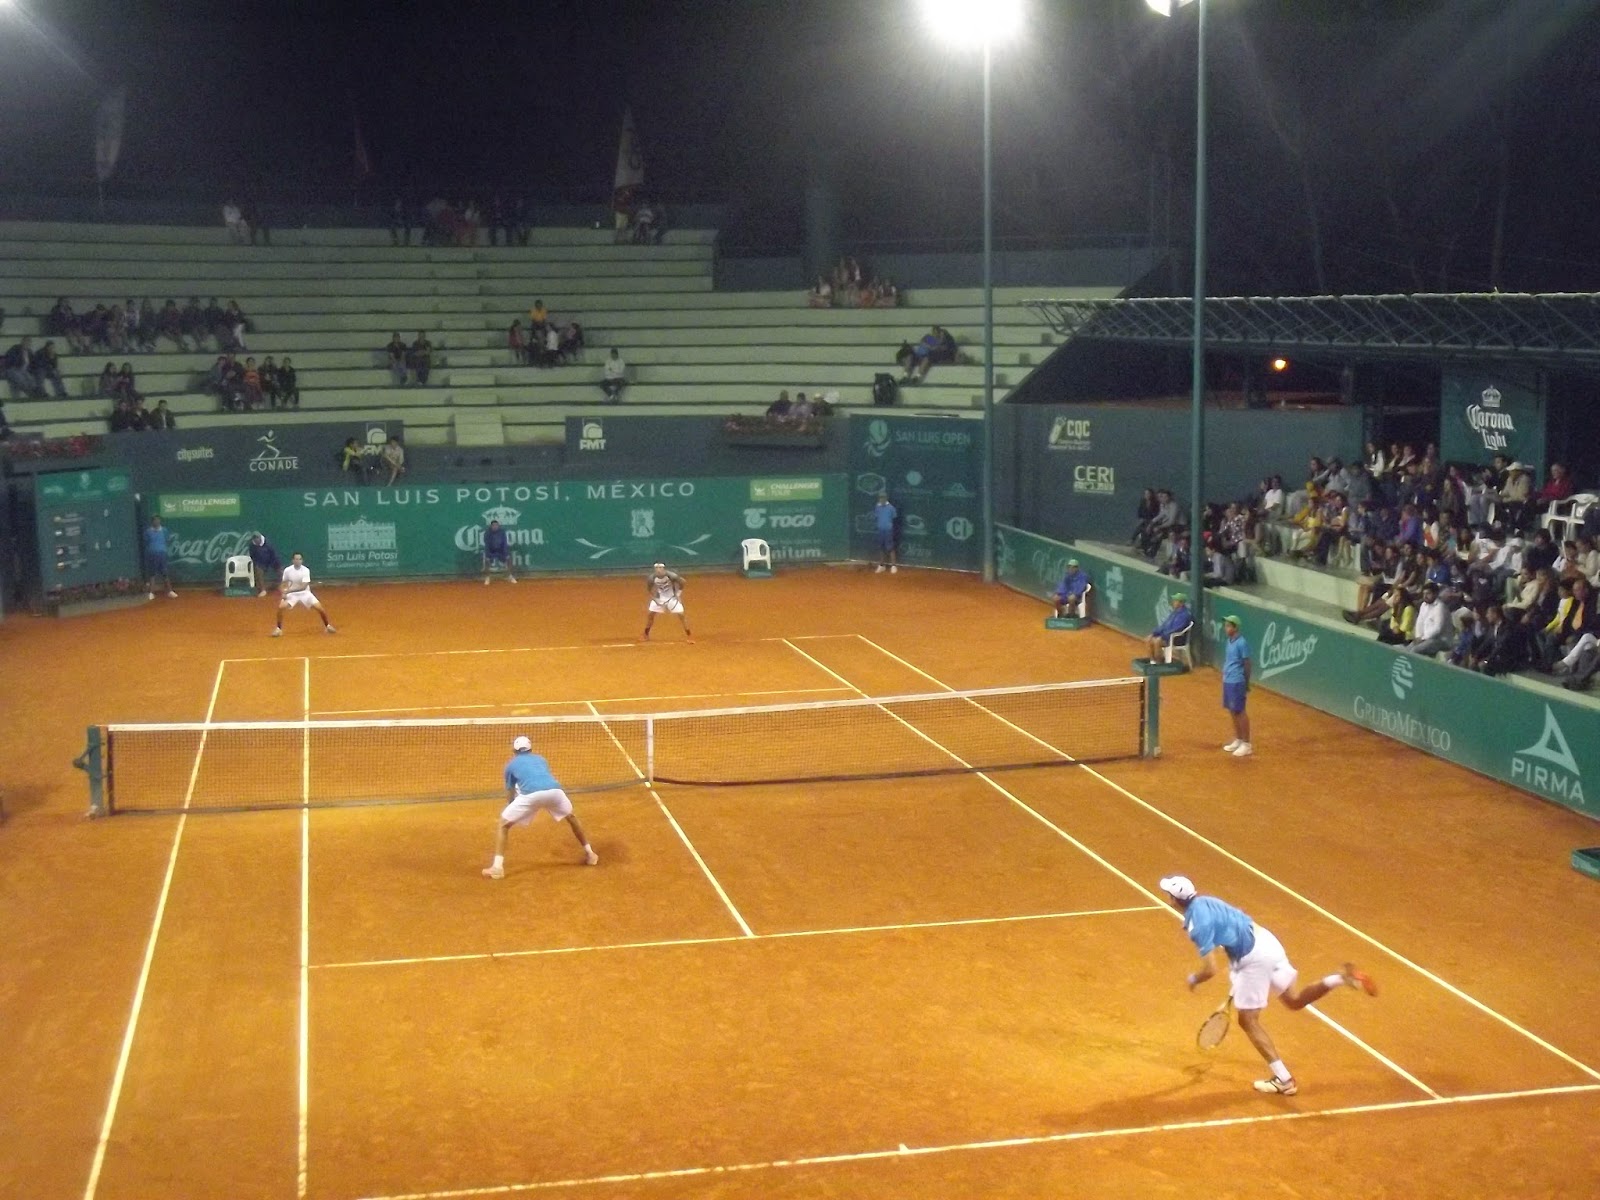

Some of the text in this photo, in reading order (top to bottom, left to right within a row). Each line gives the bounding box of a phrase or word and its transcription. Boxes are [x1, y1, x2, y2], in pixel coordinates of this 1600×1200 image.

[1465, 404, 1515, 432] Corona
[1067, 419, 1090, 439] CQC
[579, 439, 606, 450] FMT
[942, 432, 971, 446] OPEN
[1482, 430, 1508, 450] Light
[250, 459, 299, 471] CONADE
[1074, 465, 1115, 482] CERI
[303, 480, 695, 506] SAN LUIS POTOSÍ, MÉXICO
[770, 482, 820, 490] CHALLENGER
[182, 498, 237, 506] CHALLENGER
[327, 551, 344, 561] San
[346, 550, 366, 561] Luis
[1511, 756, 1585, 804] PIRMA
